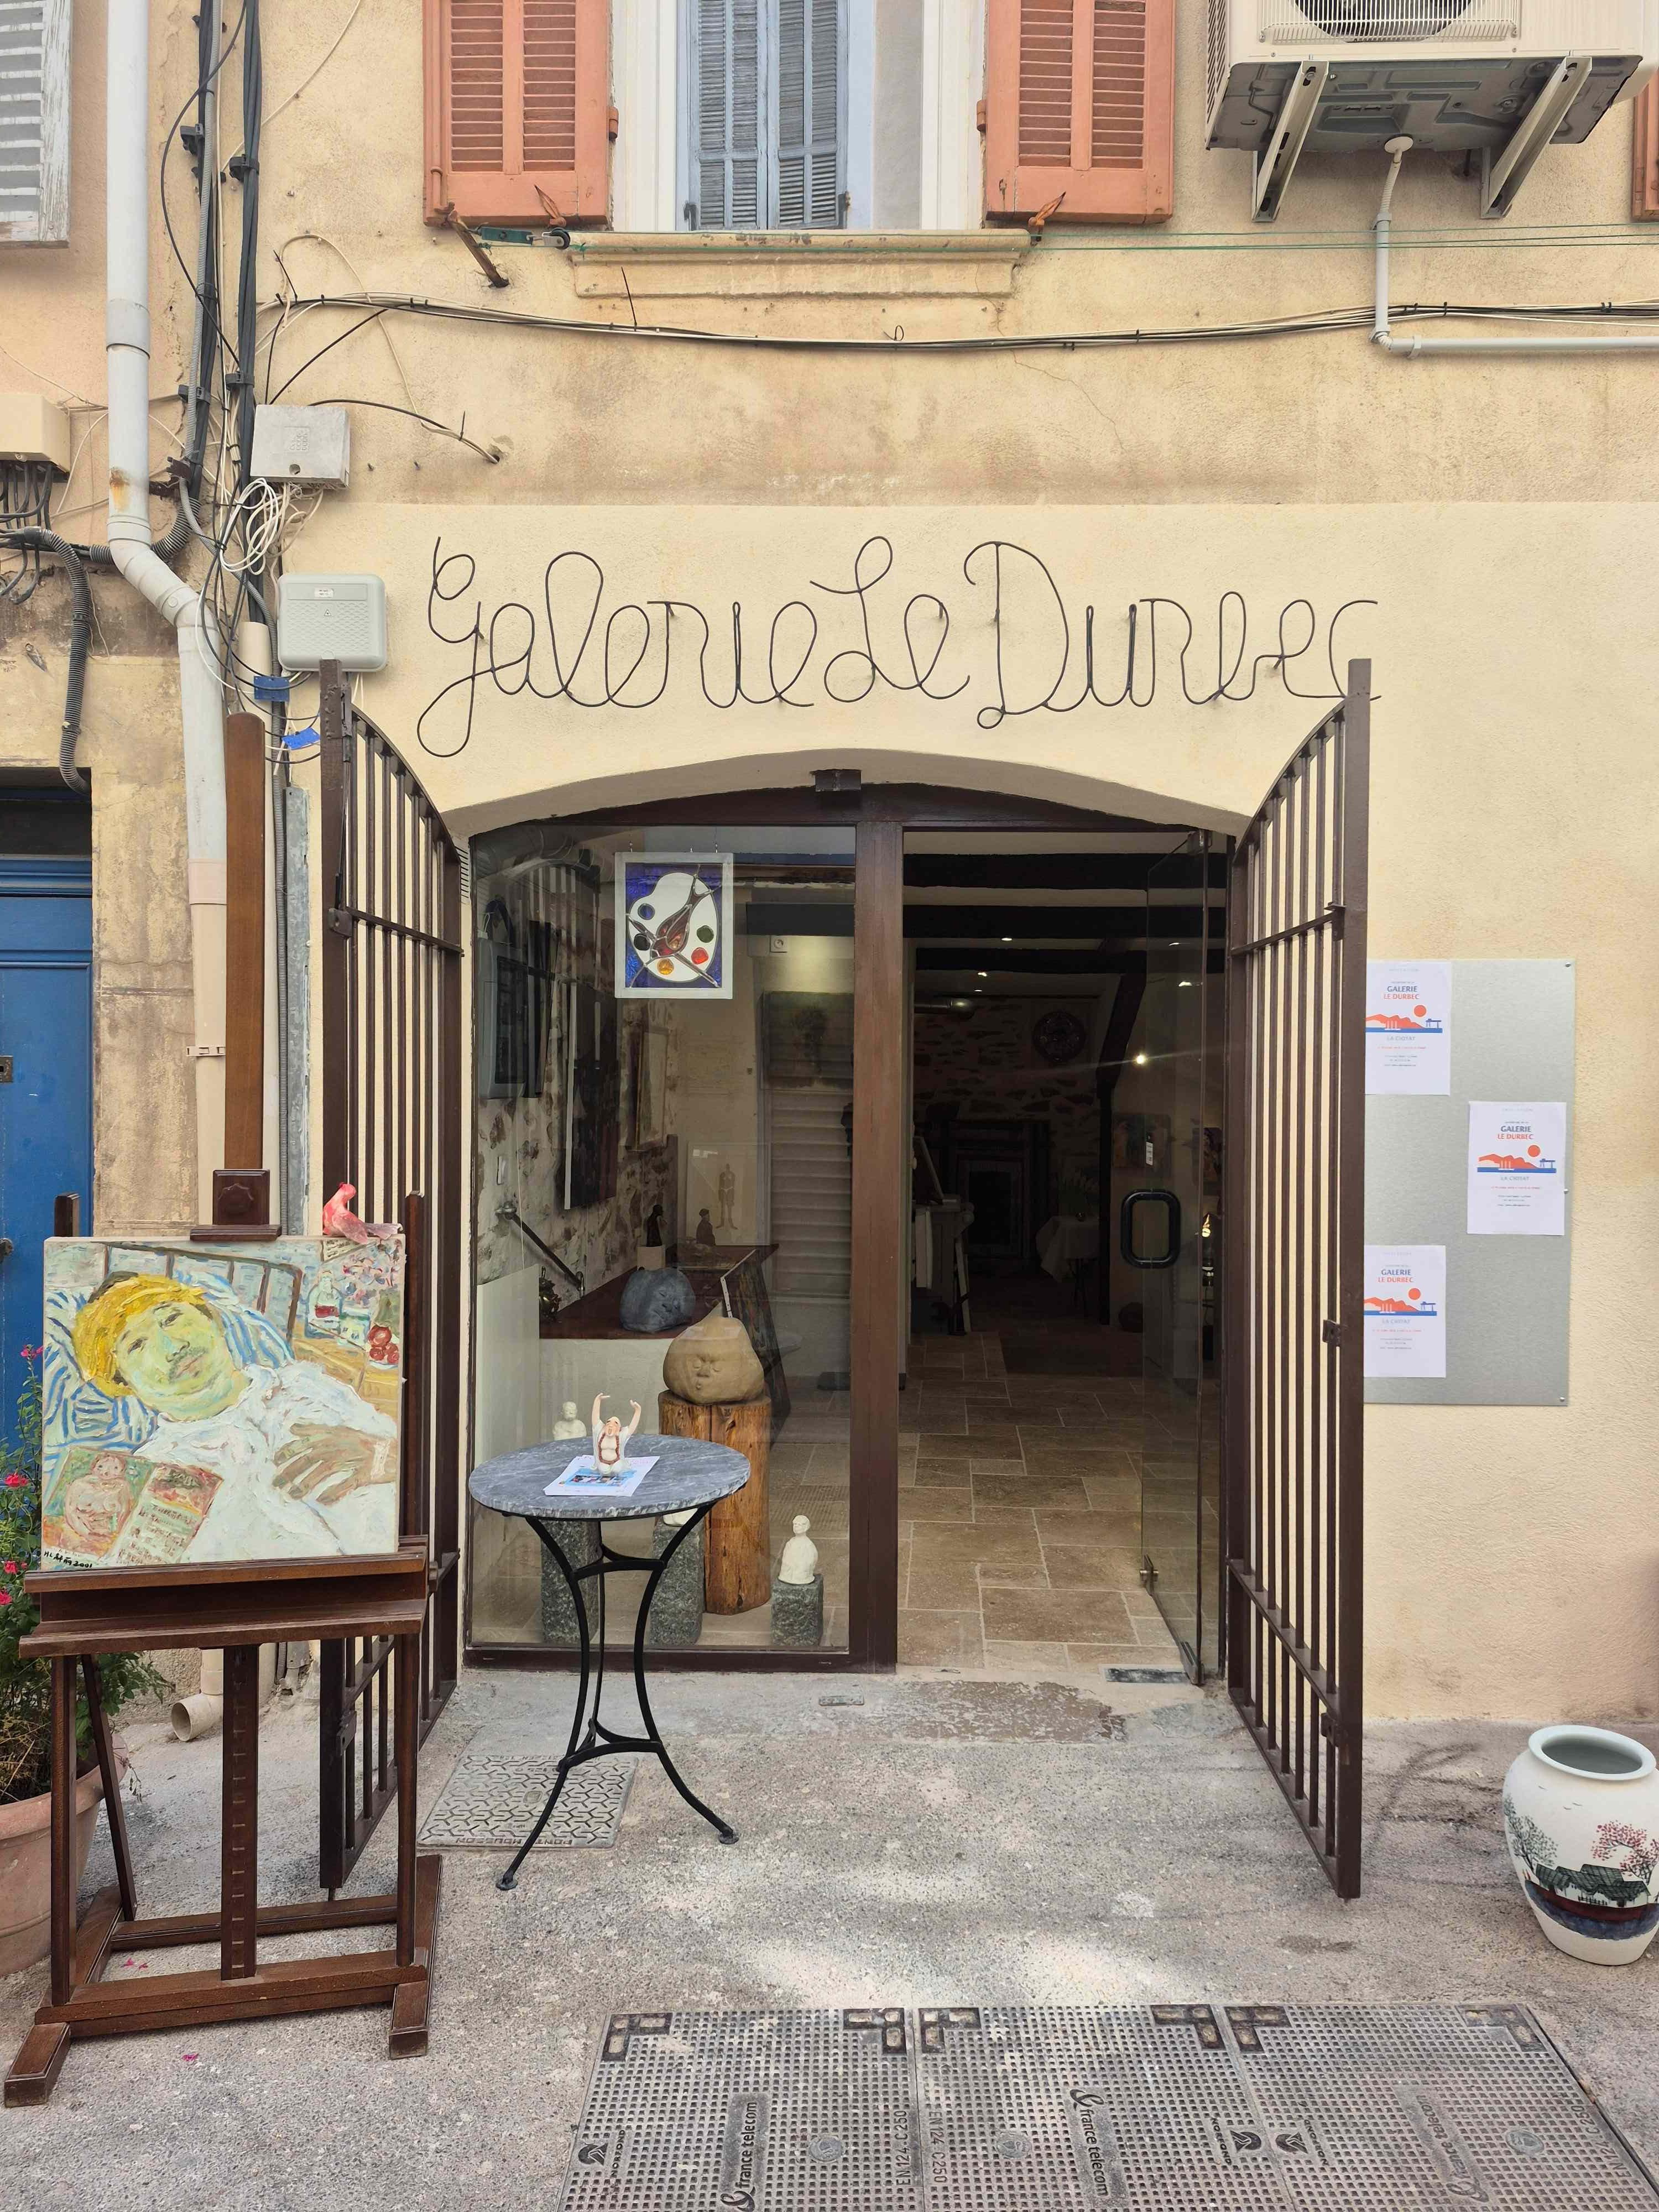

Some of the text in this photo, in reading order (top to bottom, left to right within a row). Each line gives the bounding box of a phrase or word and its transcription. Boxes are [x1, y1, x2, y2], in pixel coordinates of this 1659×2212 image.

[810, 535, 970, 702] Le
[72, 1560, 93, 1568] 2001
[610, 2130, 625, 2178] NORFOND
[735, 2102, 757, 2189] france telecom
[1080, 2109, 1108, 2196] france telecom
[1210, 2117, 1233, 2166] NORFOND
